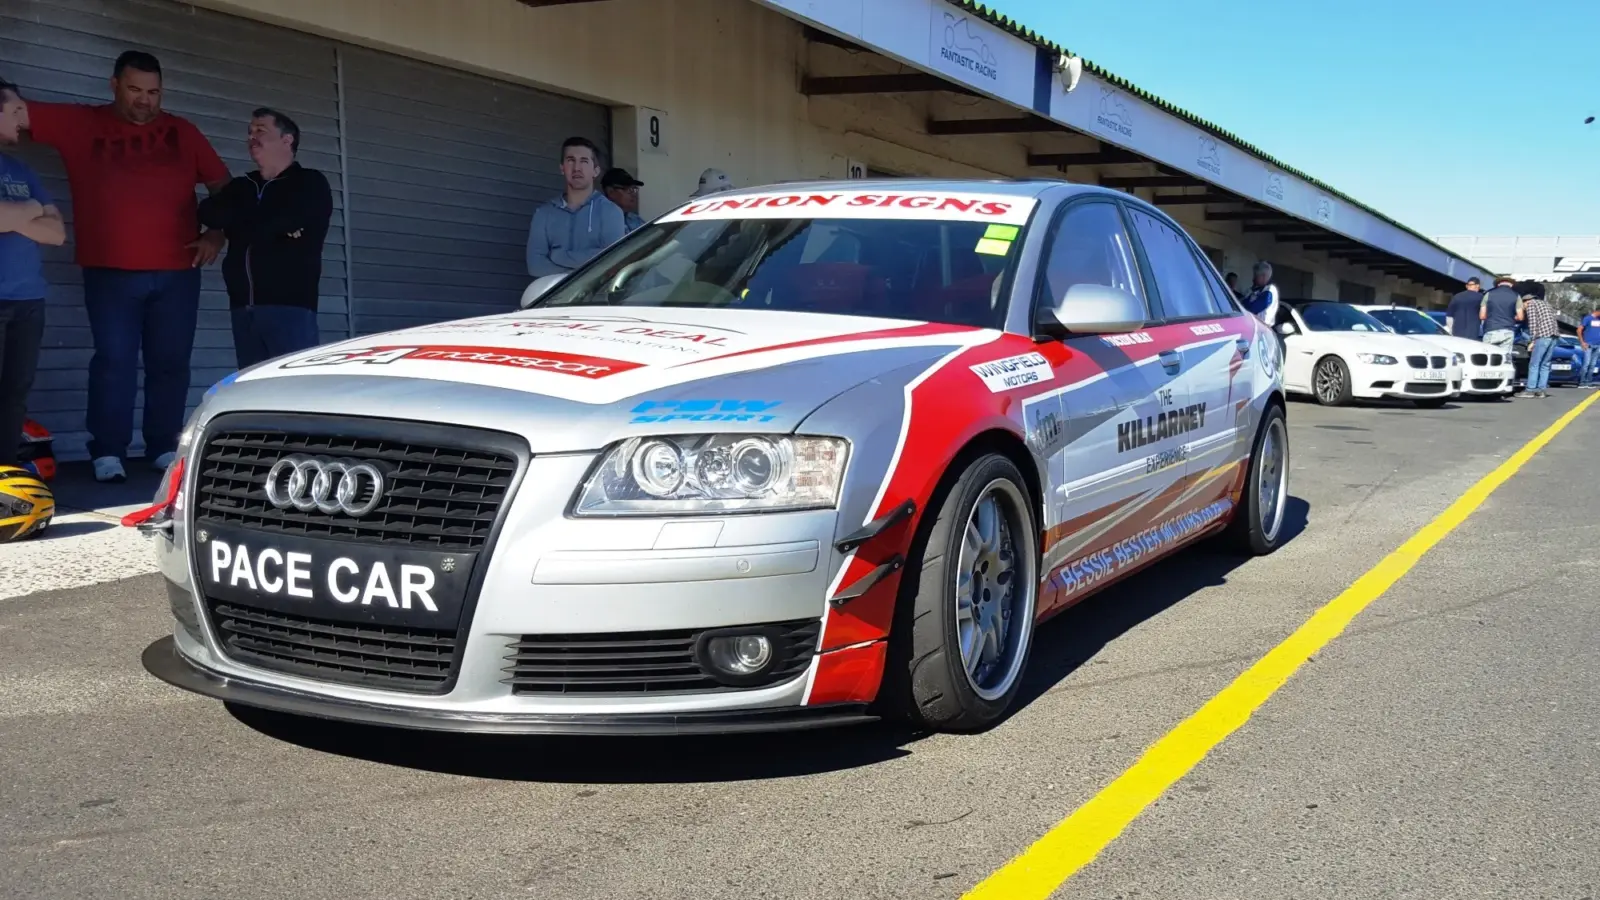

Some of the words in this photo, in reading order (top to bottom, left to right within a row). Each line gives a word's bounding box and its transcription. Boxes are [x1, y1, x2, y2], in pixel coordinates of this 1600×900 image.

[940, 47, 974, 72] FANTASTIC
[974, 61, 997, 81] RACING
[650, 115, 661, 149] 9
[850, 166, 863, 179] 10
[681, 194, 843, 217] UNION
[845, 194, 1013, 217] SIGNS
[613, 326, 729, 347] DEAL
[412, 350, 612, 376] motorsport
[975, 353, 1048, 379] WINGFIELD
[1002, 371, 1040, 388] MOTORS
[1158, 388, 1174, 407] THE
[628, 412, 778, 425] SPORT
[1117, 402, 1207, 454] KILLARNEY
[1145, 446, 1188, 475] EXPERIENCE
[1060, 547, 1114, 597] BESSIE
[1113, 525, 1162, 570] BESTER
[211, 539, 314, 599] PACE
[327, 557, 439, 612] CAR
